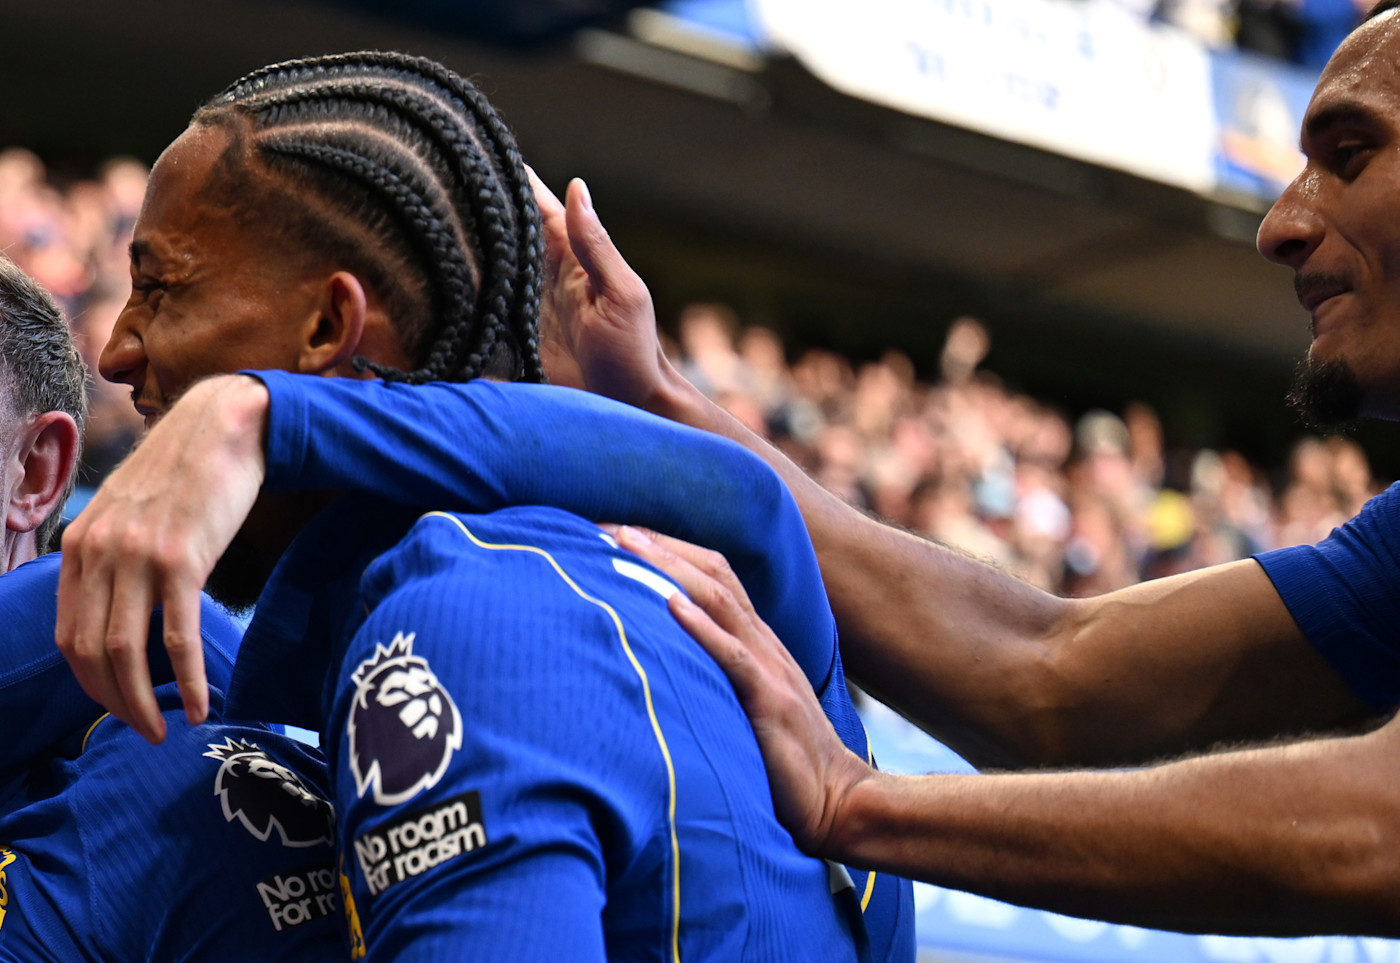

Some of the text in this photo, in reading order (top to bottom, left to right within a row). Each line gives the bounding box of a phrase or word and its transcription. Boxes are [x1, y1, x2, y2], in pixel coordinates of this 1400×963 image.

[354, 801, 469, 864] No room
[394, 822, 487, 881] racism
[256, 875, 306, 908] No
[307, 867, 337, 892] ro
